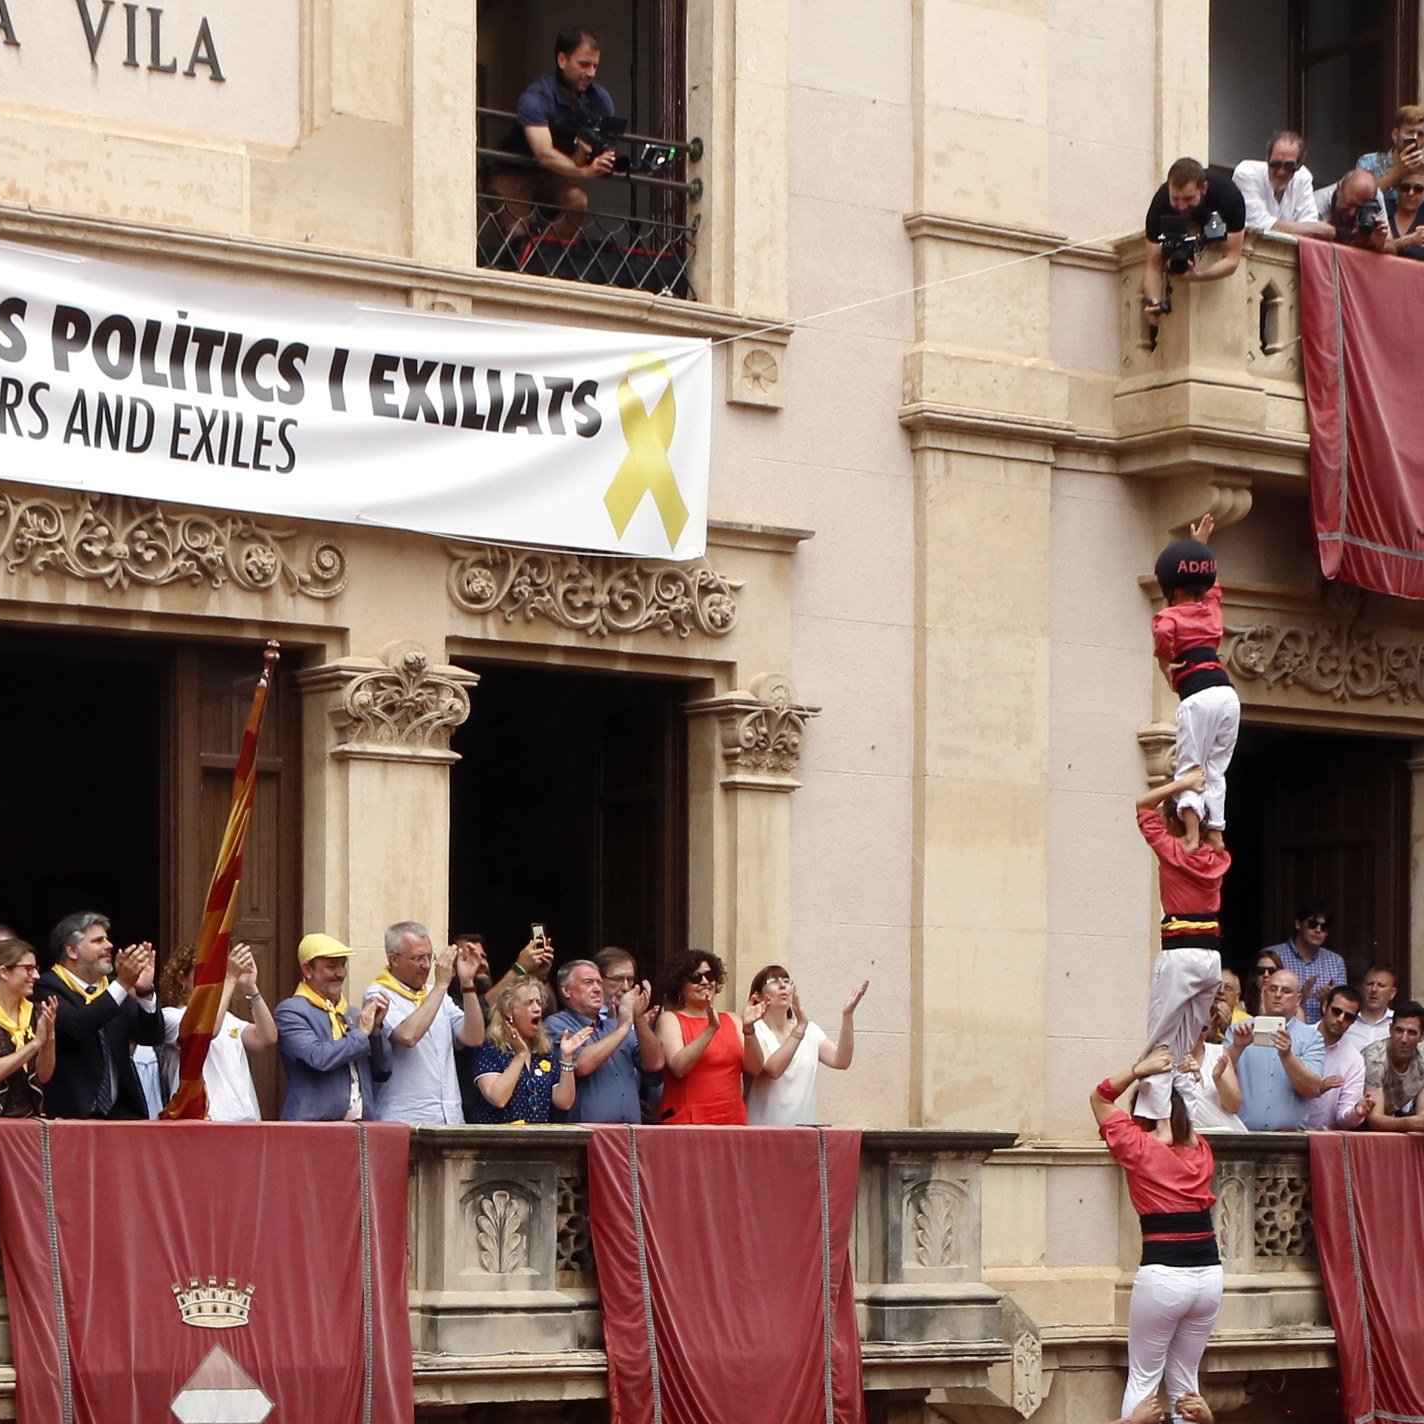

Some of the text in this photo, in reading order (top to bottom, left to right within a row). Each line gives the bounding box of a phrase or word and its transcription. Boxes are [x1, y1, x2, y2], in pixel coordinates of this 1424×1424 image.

[76, 0, 226, 82] VILA
[51, 305, 306, 405] POLÍTICS
[328, 348, 349, 412] I
[368, 353, 604, 438] EXILIATS
[63, 389, 155, 453] AND
[170, 402, 299, 474] EXILES
